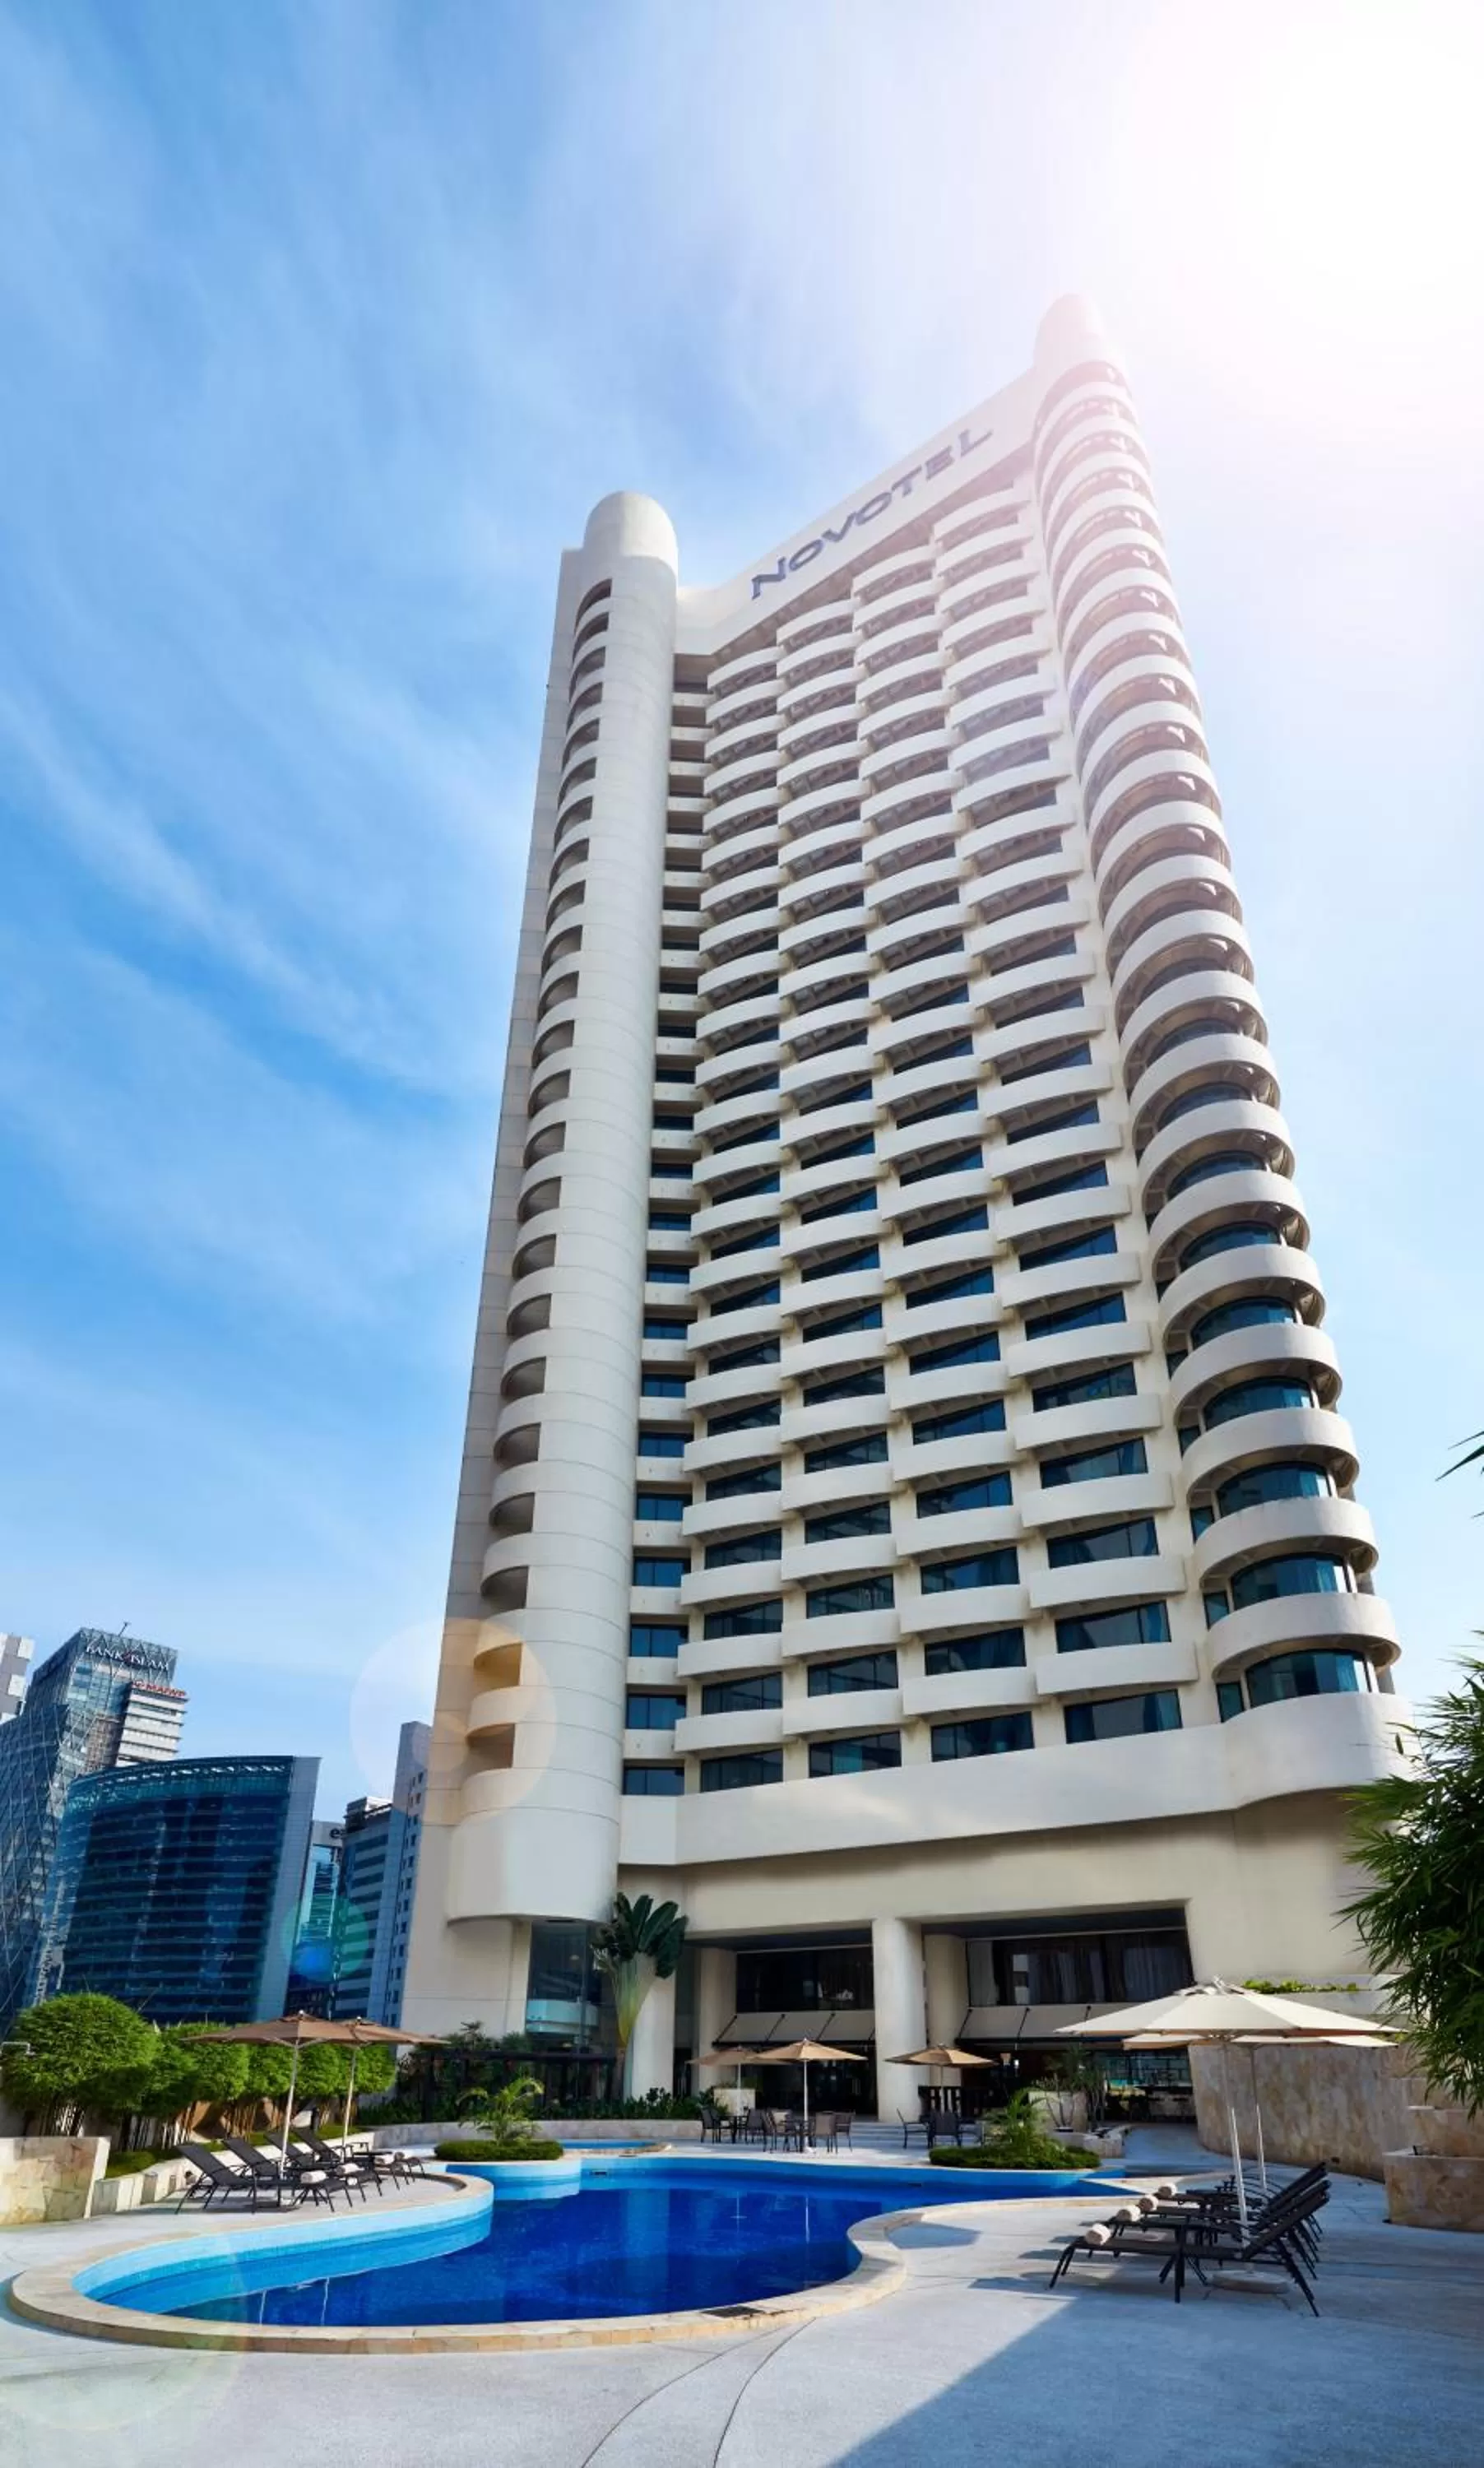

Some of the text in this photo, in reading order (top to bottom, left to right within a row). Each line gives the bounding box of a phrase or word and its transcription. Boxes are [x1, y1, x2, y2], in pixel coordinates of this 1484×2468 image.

[751, 429, 993, 601] NOVOTEL
[86, 1645, 169, 1671] BANK ISLAM
